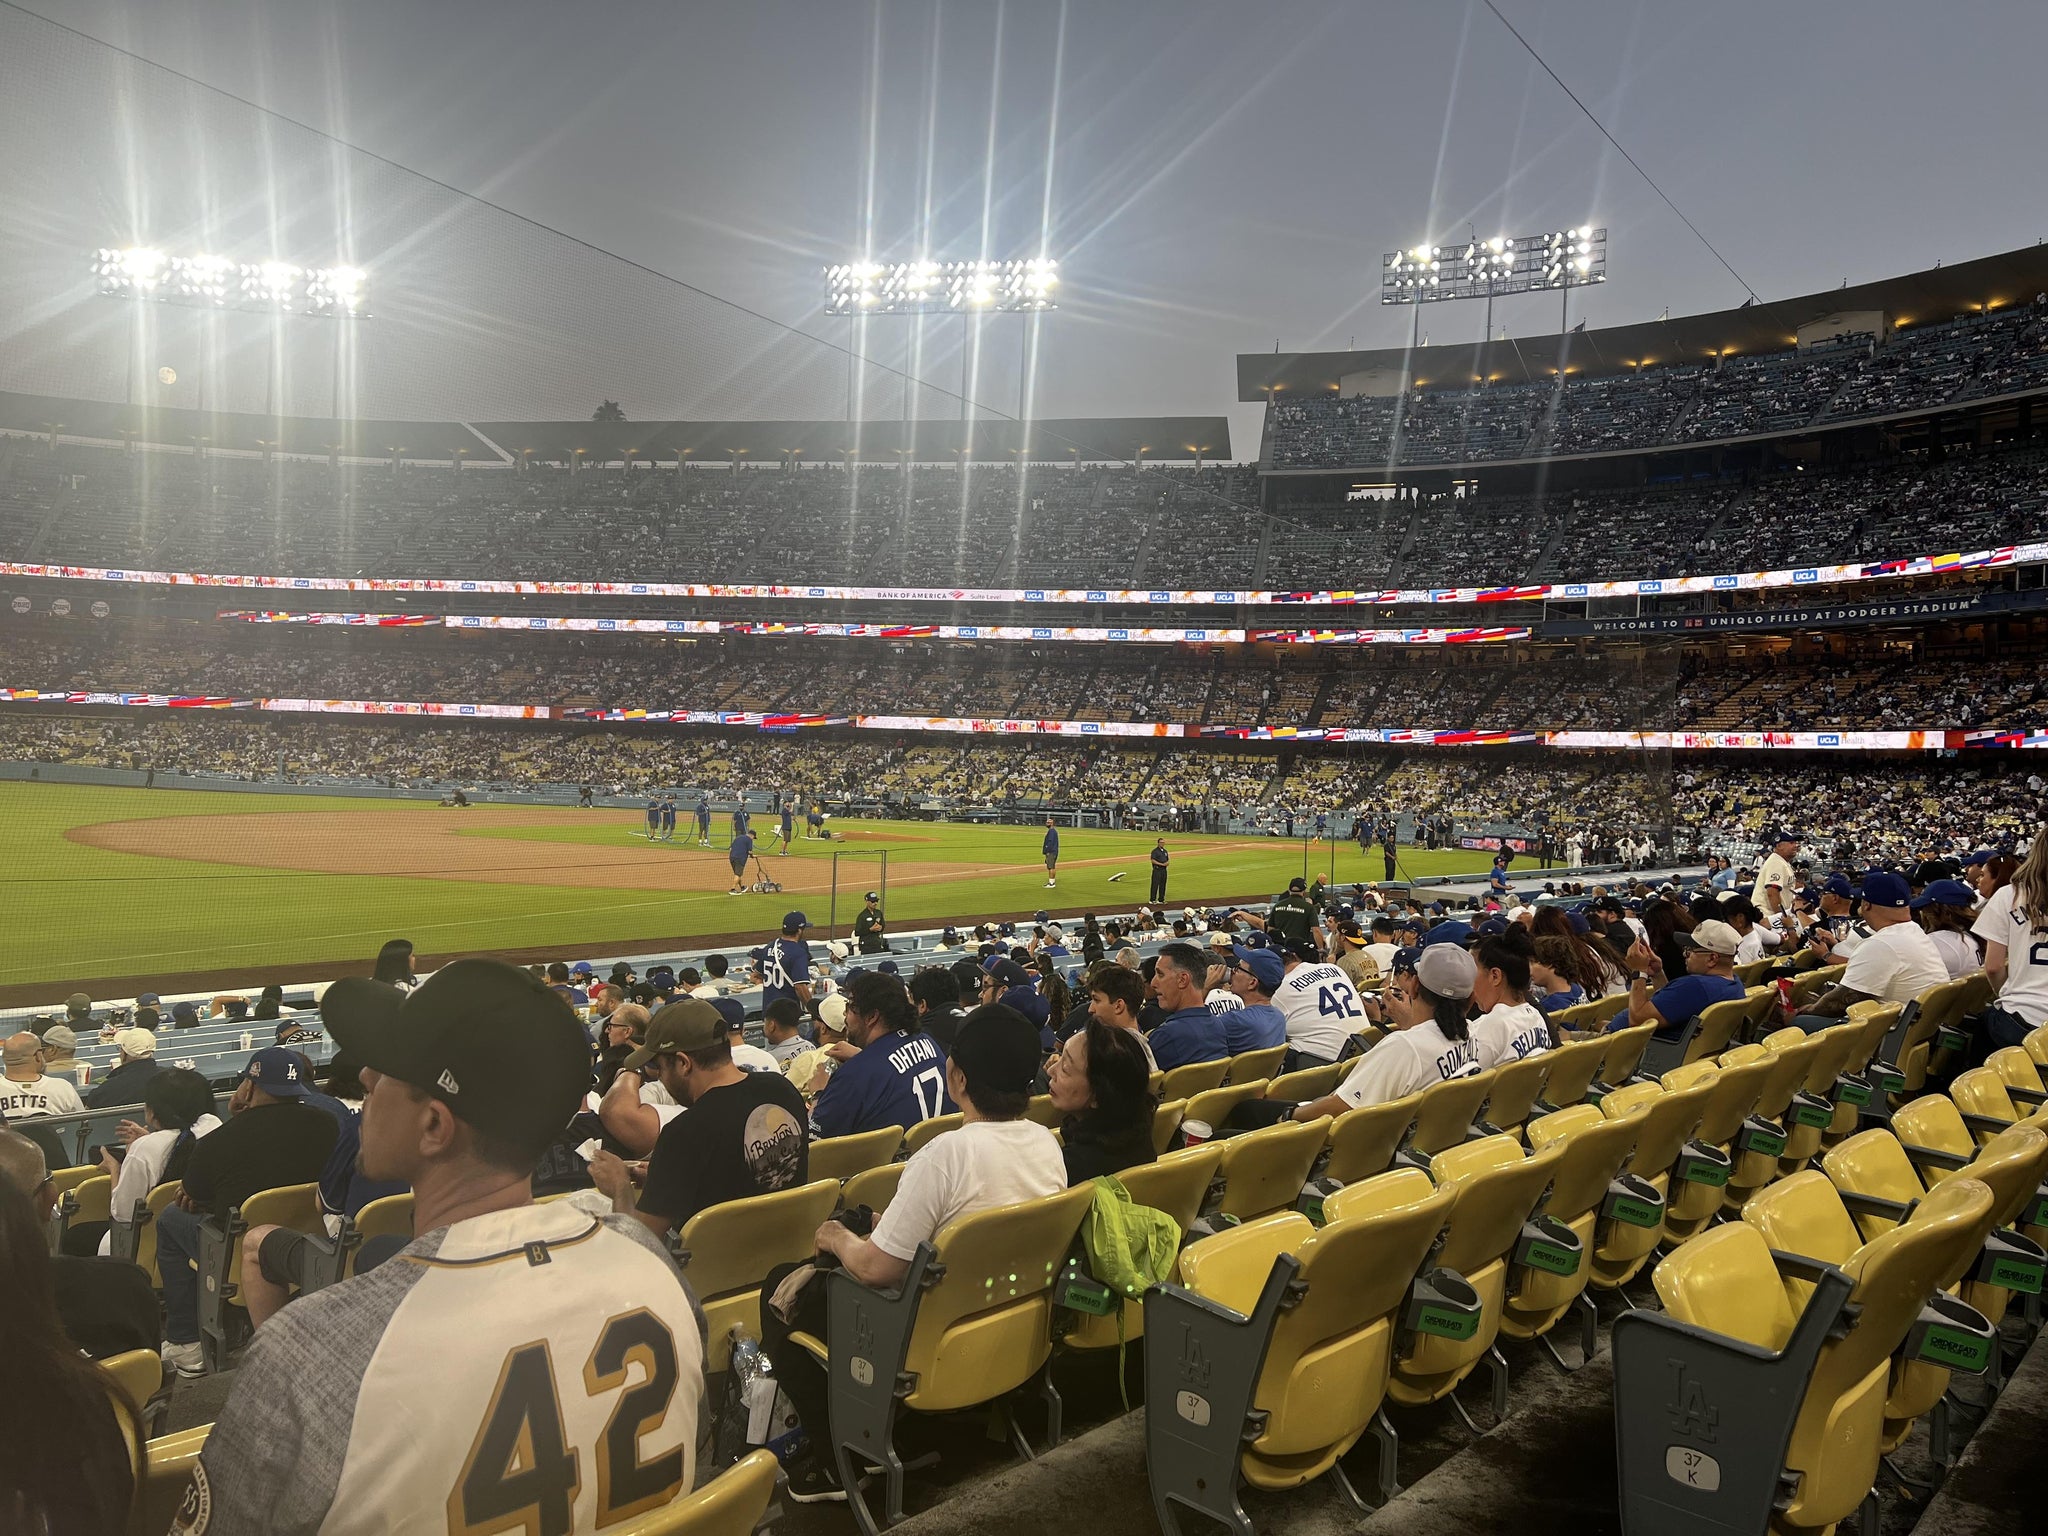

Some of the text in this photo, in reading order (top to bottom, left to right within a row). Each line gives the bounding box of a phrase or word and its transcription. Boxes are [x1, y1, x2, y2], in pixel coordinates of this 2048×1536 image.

[1716, 577, 1736, 587] UCLA
[1796, 572, 1815, 581] UCLA
[1641, 582, 1659, 591] UCLA
[1088, 592, 1104, 600] UCLA
[1151, 592, 1168, 600] UCLA
[1593, 621, 1656, 630] WELCOME
[1662, 620, 1678, 628] TO
[1710, 616, 1763, 627] UNIQLO
[1770, 613, 1808, 622] FIELD
[1814, 612, 1833, 620] AT
[1838, 606, 1897, 619] DODGER
[1903, 601, 1969, 614] STADIUM
[464, 618, 479, 626] UCLA
[600, 621, 614, 629] UCLA
[668, 622, 683, 630] UCLA
[1110, 631, 1126, 639] UCLA
[1187, 632, 1203, 640] UCLA
[1819, 735, 1837, 744] UCLA
[763, 960, 785, 990] 50
[1290, 967, 1341, 992] ROBINSON
[1318, 982, 1362, 1020] 42
[888, 1038, 937, 1074] OHTANI
[287, 1063, 298, 1080] LA
[912, 1065, 944, 1121] 17
[0, 1094, 48, 1111] BETTS
[532, 1245, 544, 1262] B
[858, 1360, 867, 1370] 37
[859, 1371, 865, 1381] H
[1187, 1395, 1200, 1408] 37
[1665, 1357, 1720, 1445] LA
[447, 1305, 683, 1536] 42
[1190, 1409, 1195, 1420] J
[1684, 1452, 1702, 1468] 37
[1688, 1469, 1698, 1485] K
